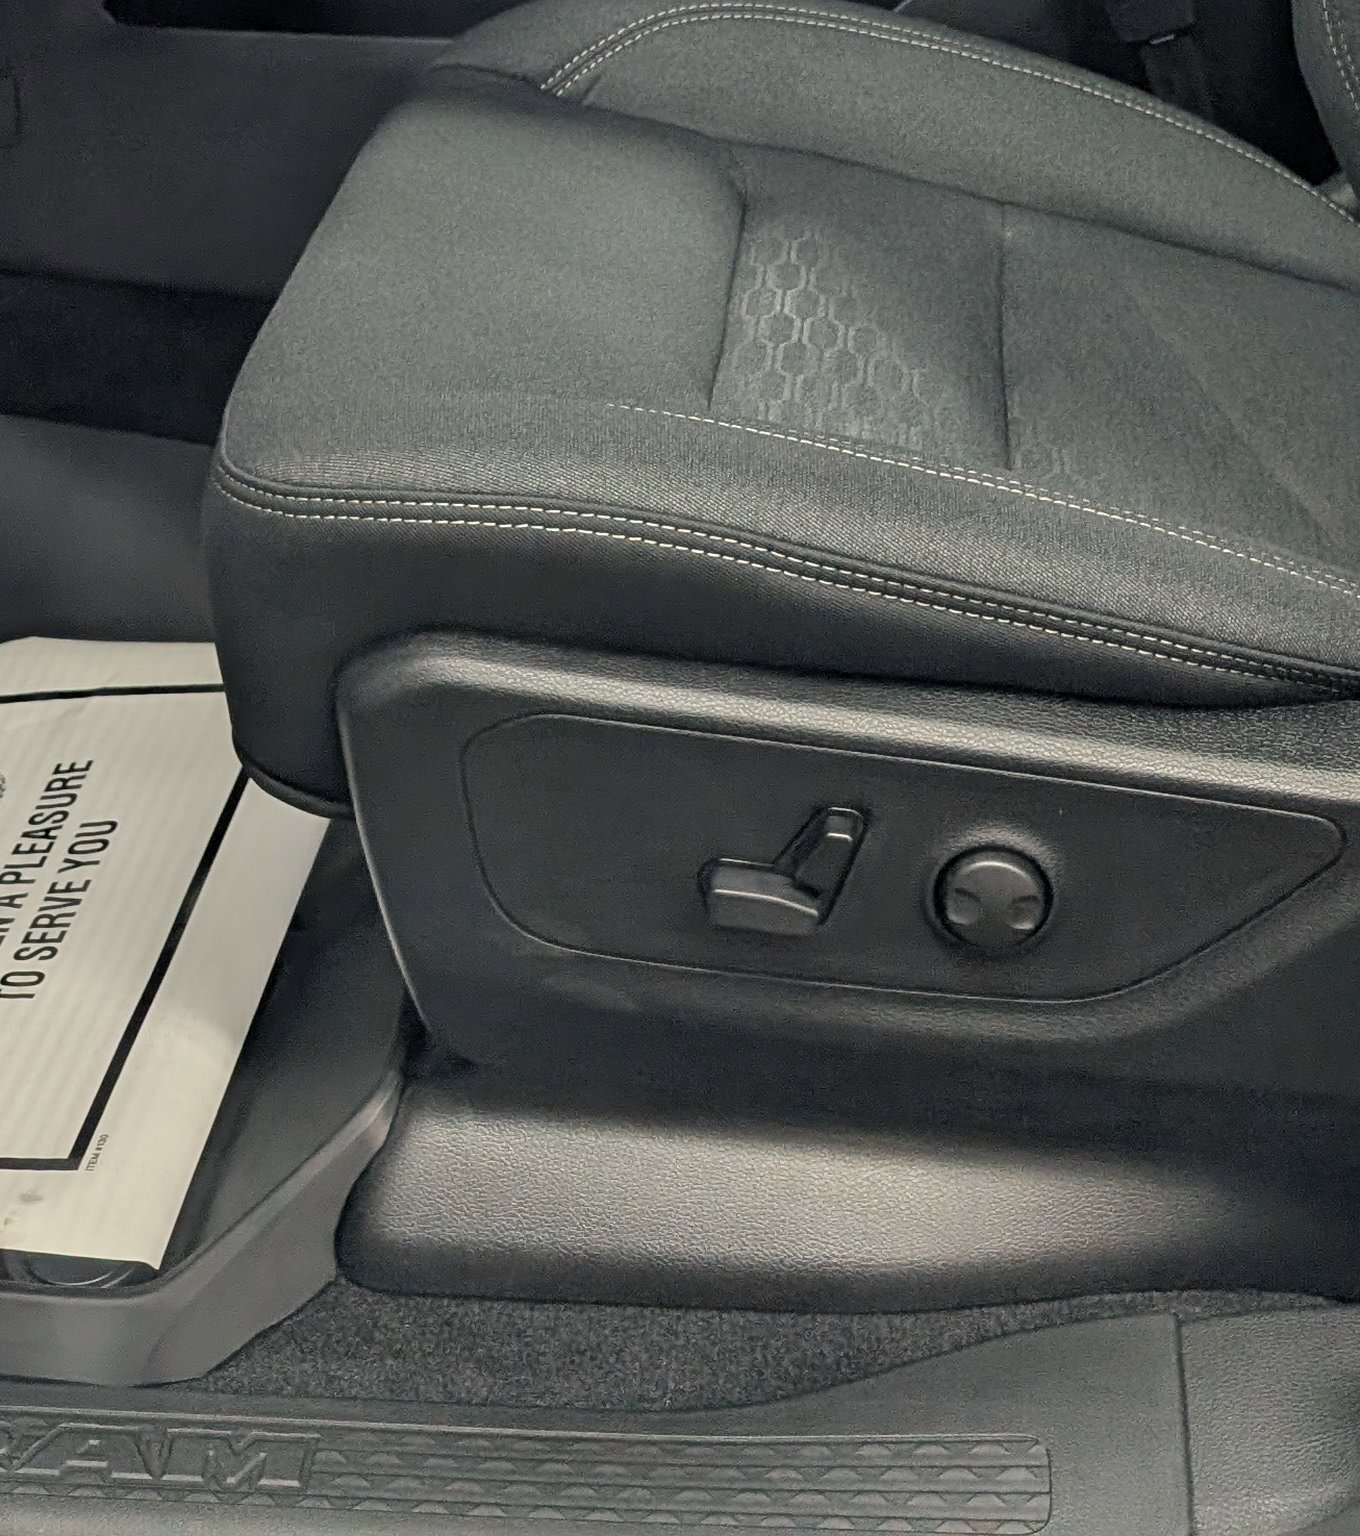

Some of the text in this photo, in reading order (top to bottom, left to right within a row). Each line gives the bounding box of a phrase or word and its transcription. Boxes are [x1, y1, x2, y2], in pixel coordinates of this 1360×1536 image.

[12, 879, 91, 961] SERVE
[57, 819, 119, 874] YOU
[85, 1152, 101, 1171] ITEM
